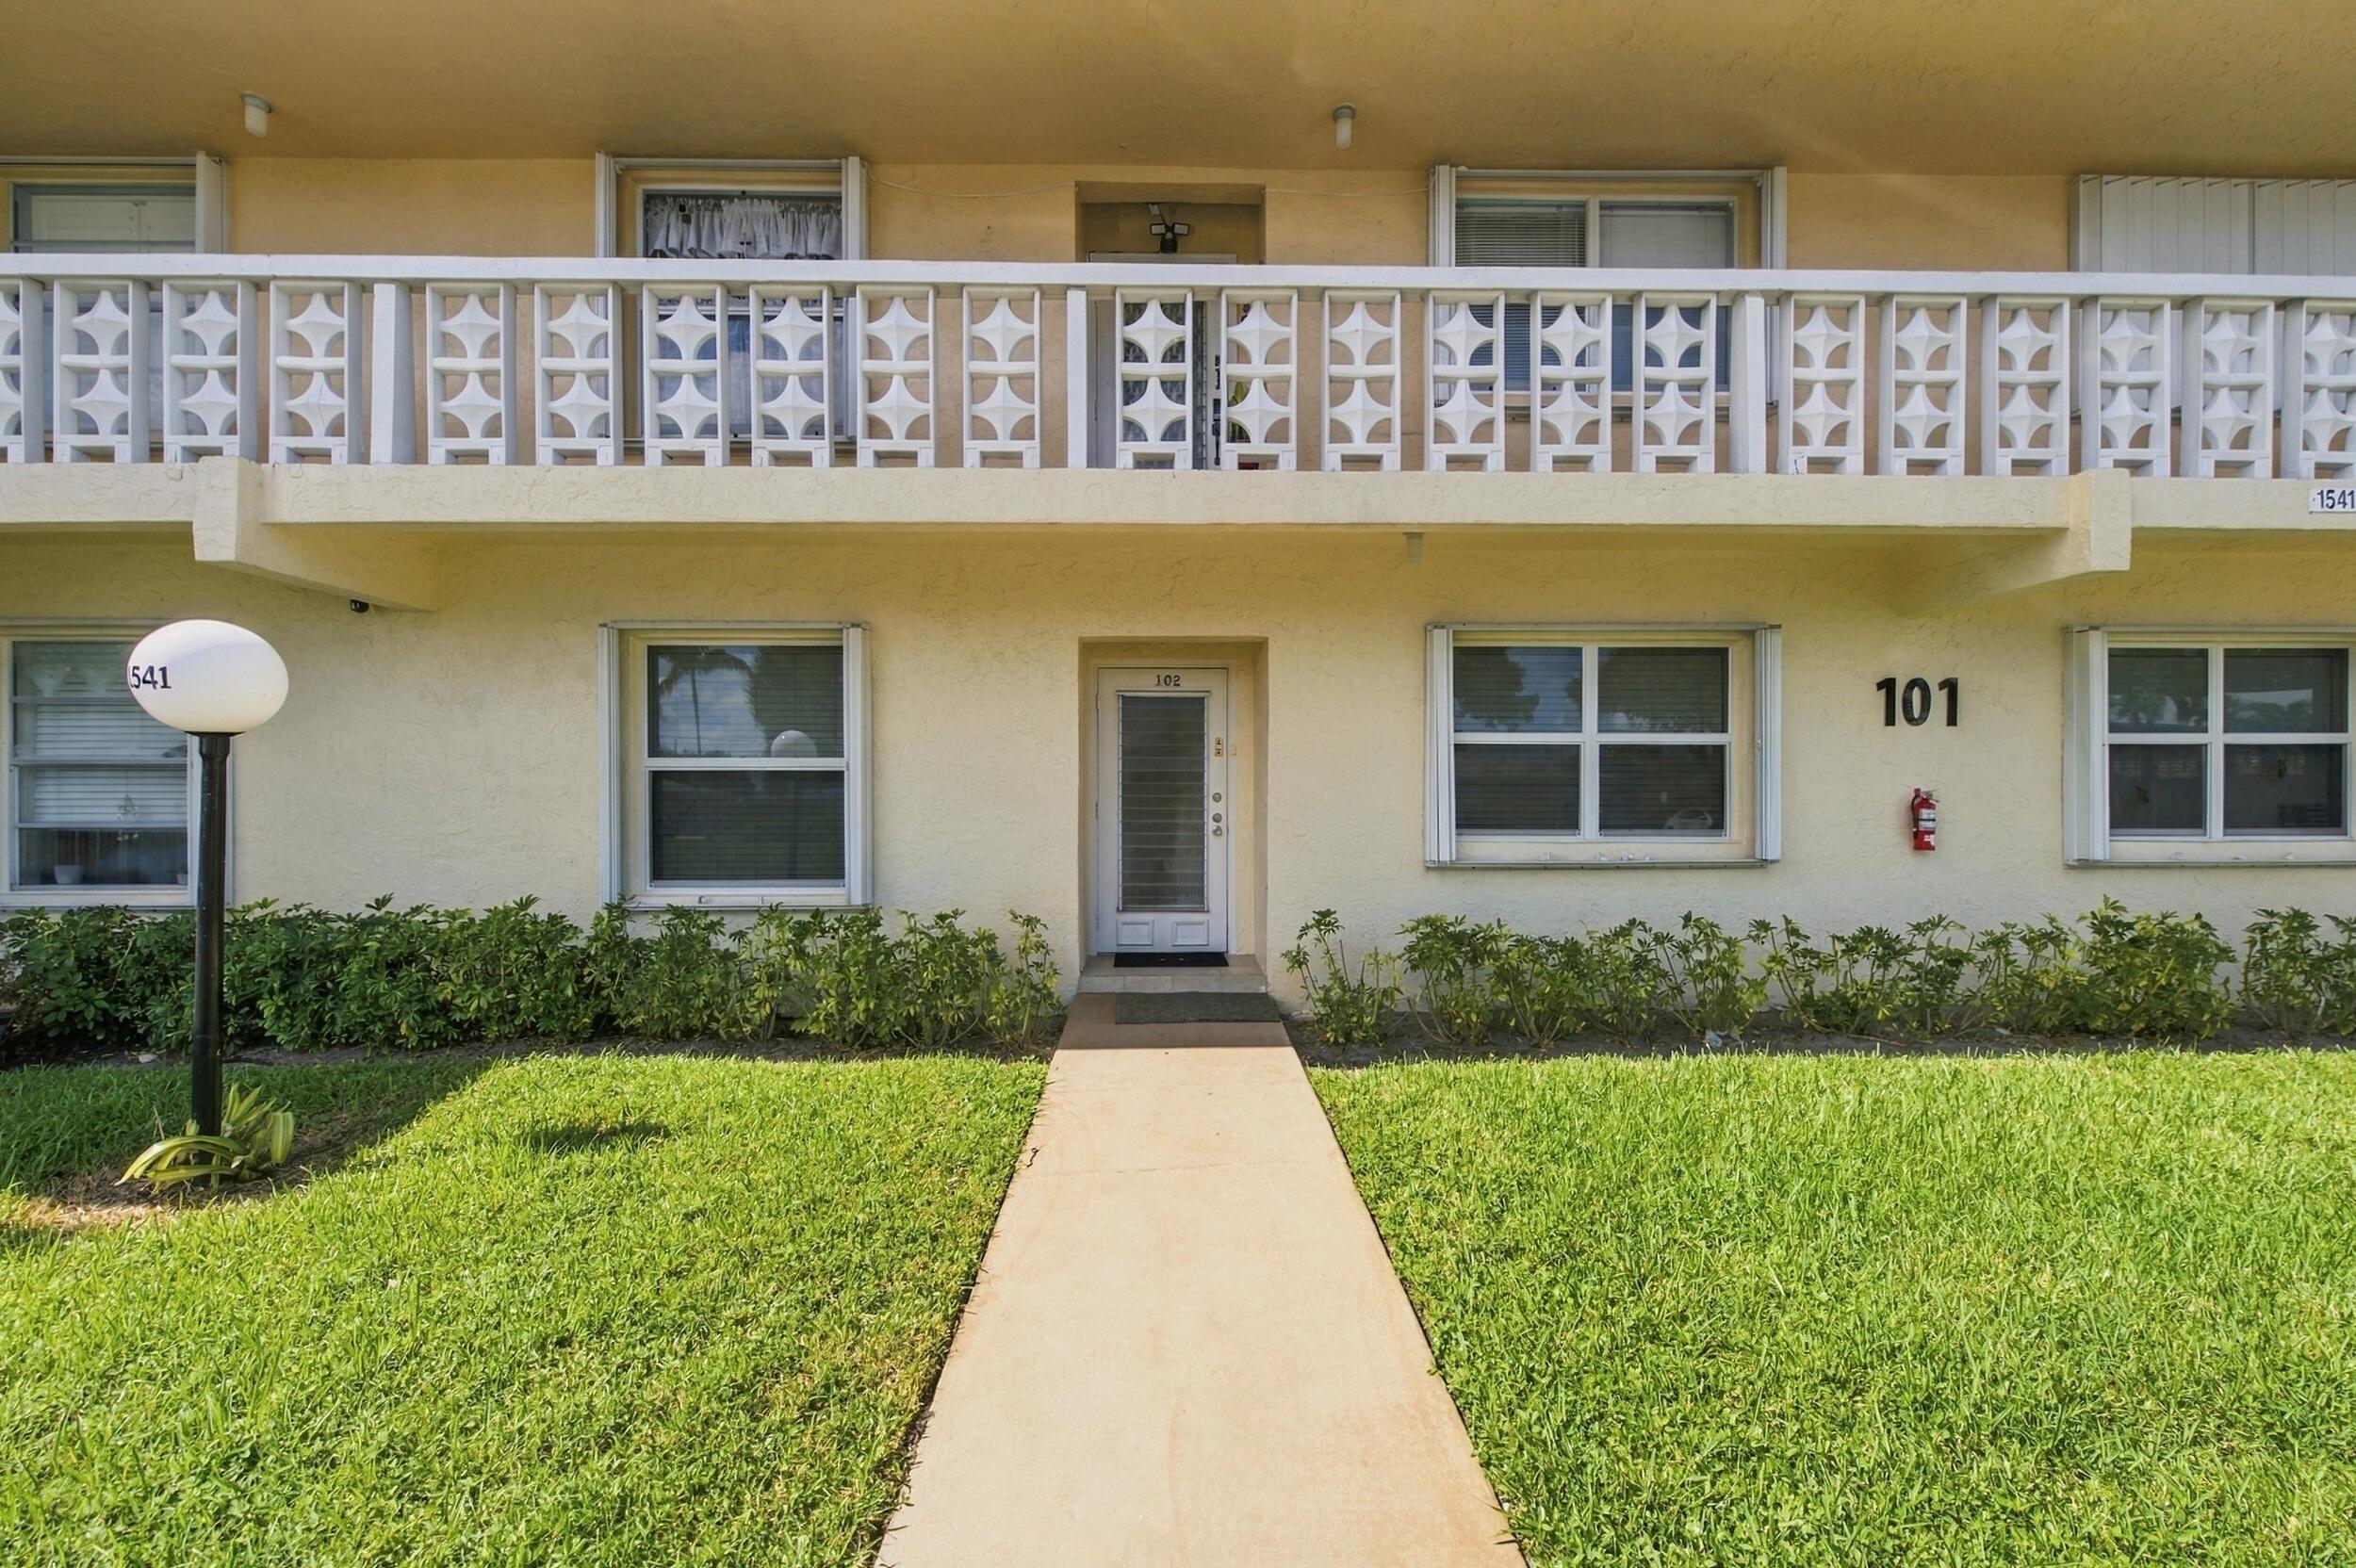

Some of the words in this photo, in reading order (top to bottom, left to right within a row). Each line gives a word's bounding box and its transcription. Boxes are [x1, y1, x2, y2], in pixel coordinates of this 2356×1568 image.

[2316, 489, 2355, 509] 1541
[1154, 674, 1181, 687] 102
[1875, 677, 1959, 727] 101
